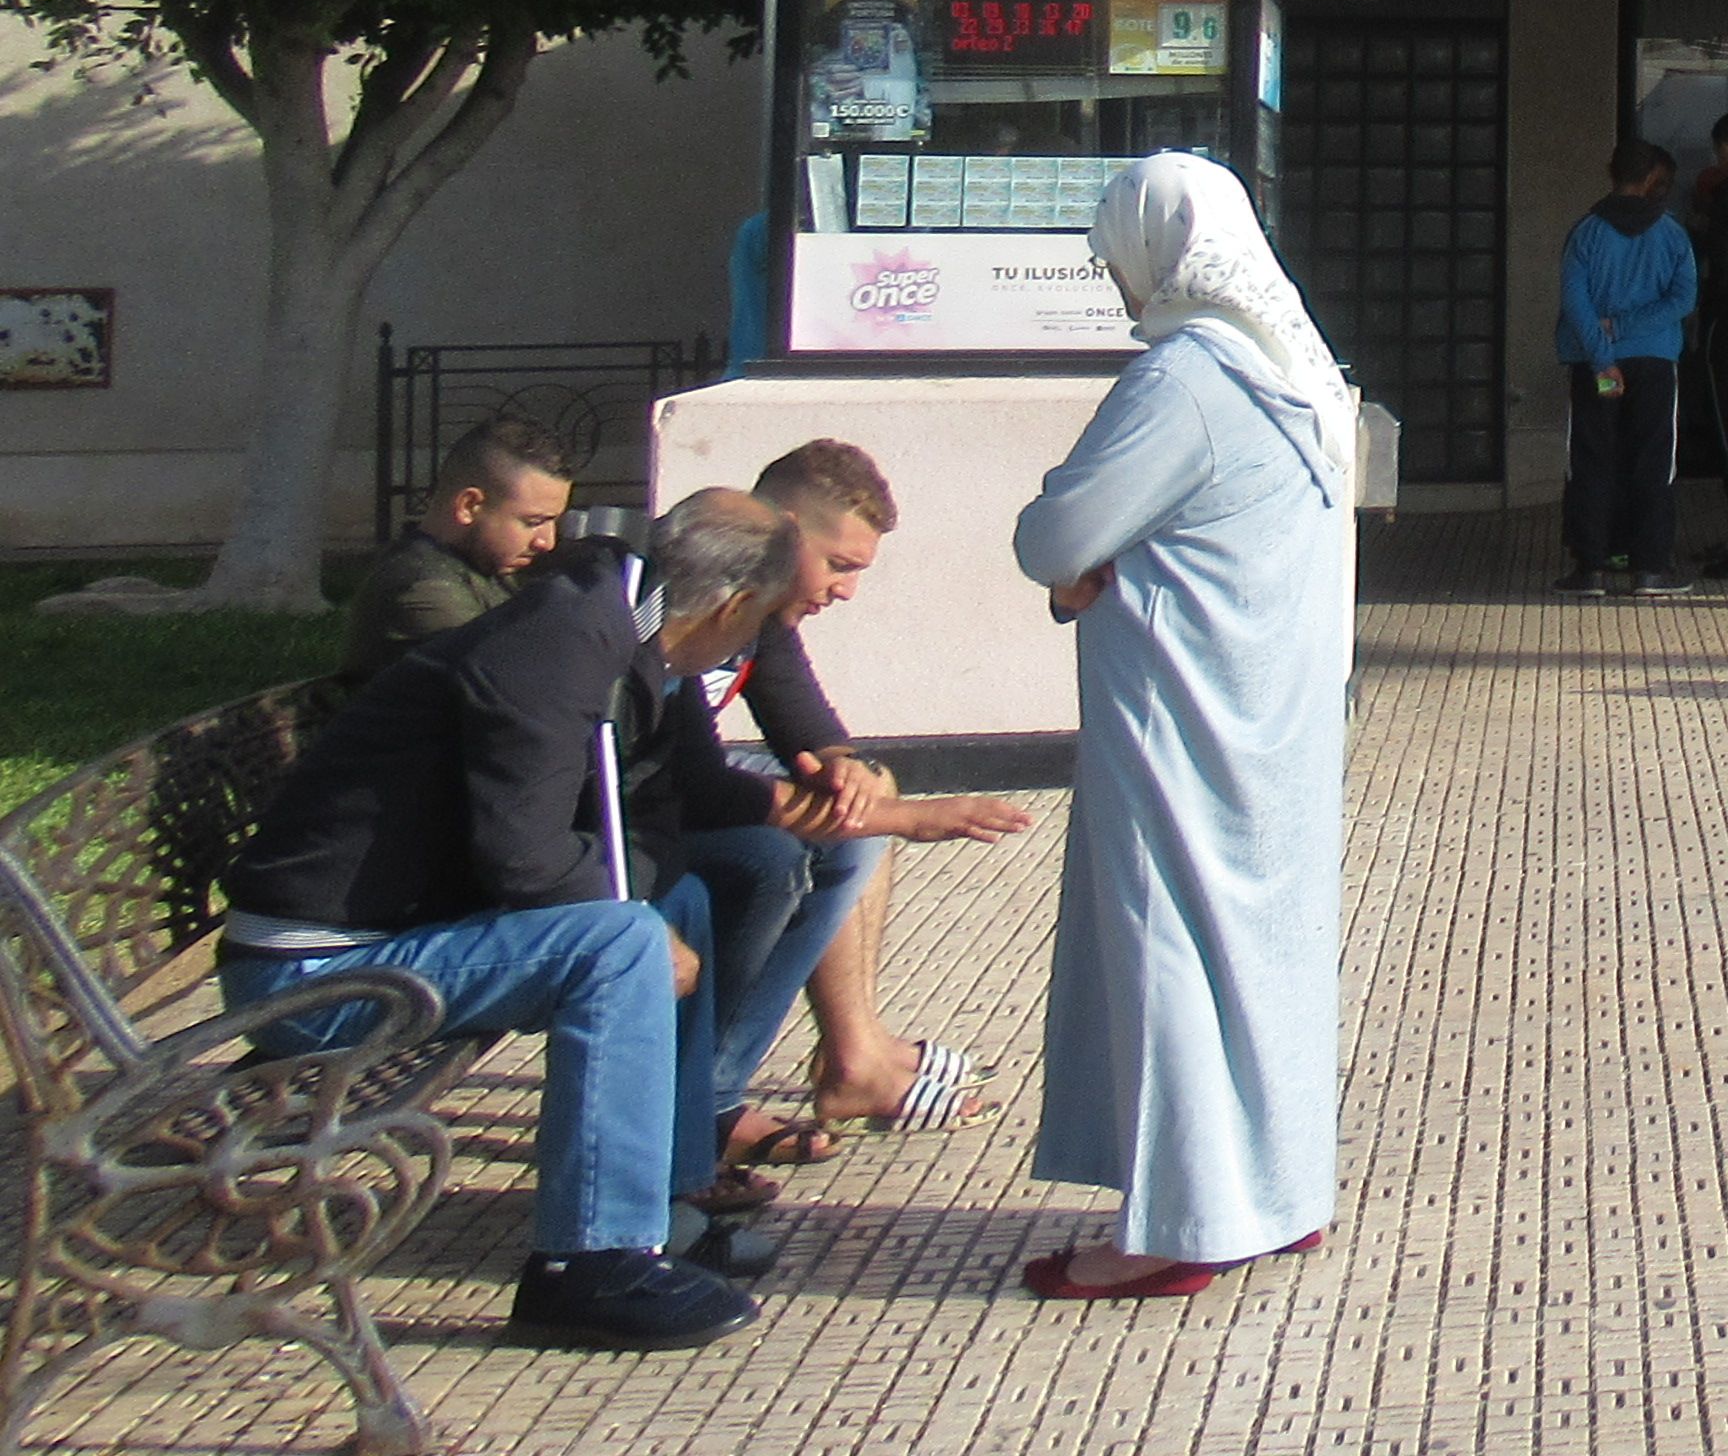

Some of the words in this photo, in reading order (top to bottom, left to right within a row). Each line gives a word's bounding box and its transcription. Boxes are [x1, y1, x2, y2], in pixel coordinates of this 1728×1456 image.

[992, 266, 1018, 280] TU
[851, 283, 938, 311] Once
[1085, 307, 1125, 318] ONCE
